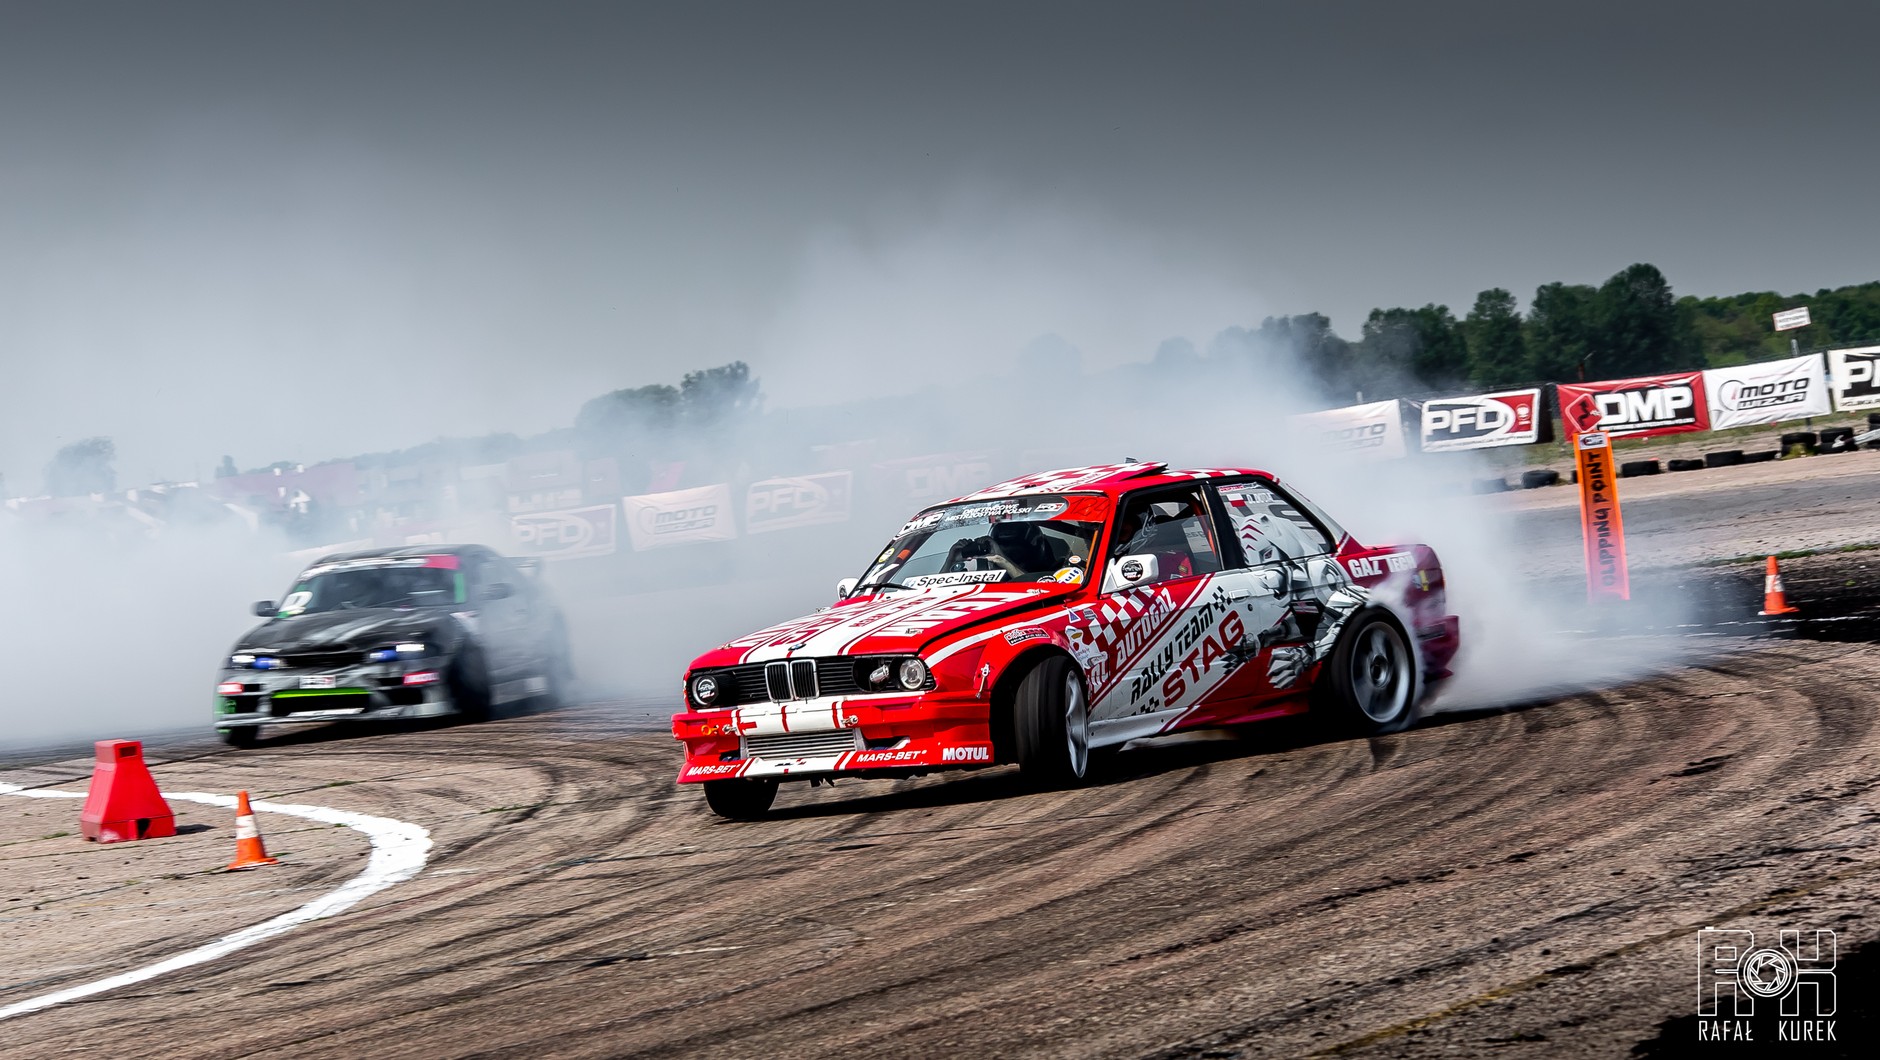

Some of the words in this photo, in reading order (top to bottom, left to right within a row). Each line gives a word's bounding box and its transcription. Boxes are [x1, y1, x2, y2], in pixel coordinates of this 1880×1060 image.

[1738, 391, 1807, 410] WIZJA
[1740, 377, 1810, 399] MOTO
[1595, 386, 1693, 425] DMP
[1427, 409, 1507, 437] PFD
[1585, 451, 1610, 504] POINT
[656, 504, 717, 523] MOTO
[1001, 507, 1032, 516] POLSKI
[515, 521, 584, 546] PFD
[1347, 556, 1383, 579] GAZ
[1385, 551, 1418, 573] TECH
[917, 571, 1002, 589] Spec-Instal
[1130, 640, 1174, 706] RALLY
[1174, 601, 1215, 657] TEAM
[1162, 609, 1245, 708] STAG
[942, 747, 989, 760] MOTUL
